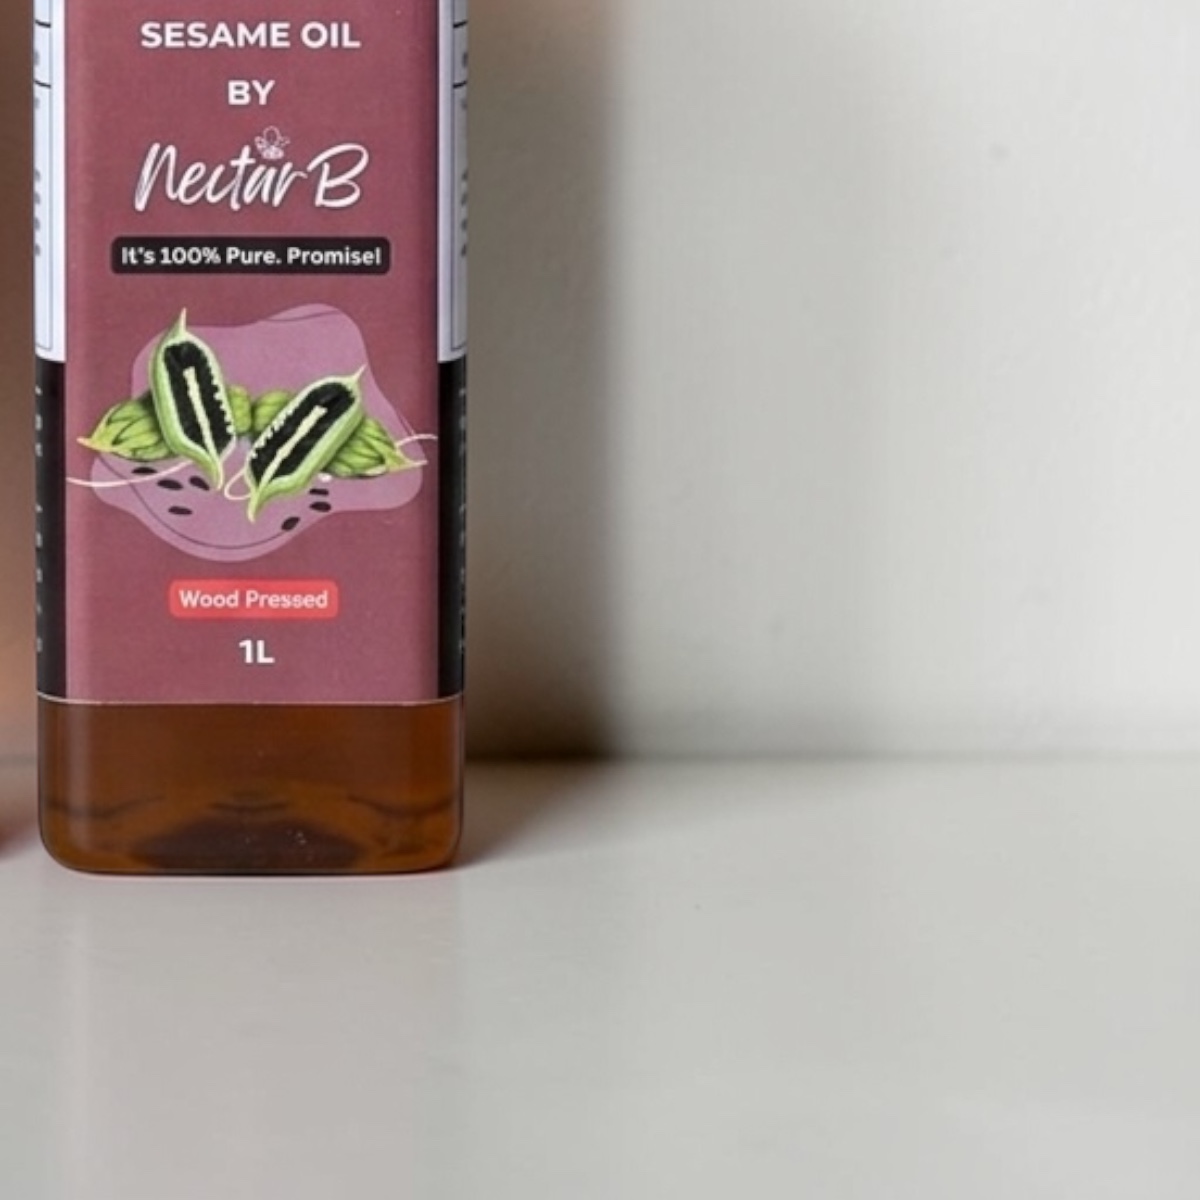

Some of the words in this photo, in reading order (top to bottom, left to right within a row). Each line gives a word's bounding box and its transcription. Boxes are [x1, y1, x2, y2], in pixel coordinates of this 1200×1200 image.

[140, 21, 291, 49] SESAME
[300, 21, 361, 49] OIL
[227, 79, 275, 106] BY
[121, 246, 156, 265] It's
[160, 246, 222, 265] 100%
[225, 246, 282, 265] Pure.
[178, 589, 239, 609] Wood
[245, 589, 328, 609] Pressed
[238, 639, 275, 664] 1L
